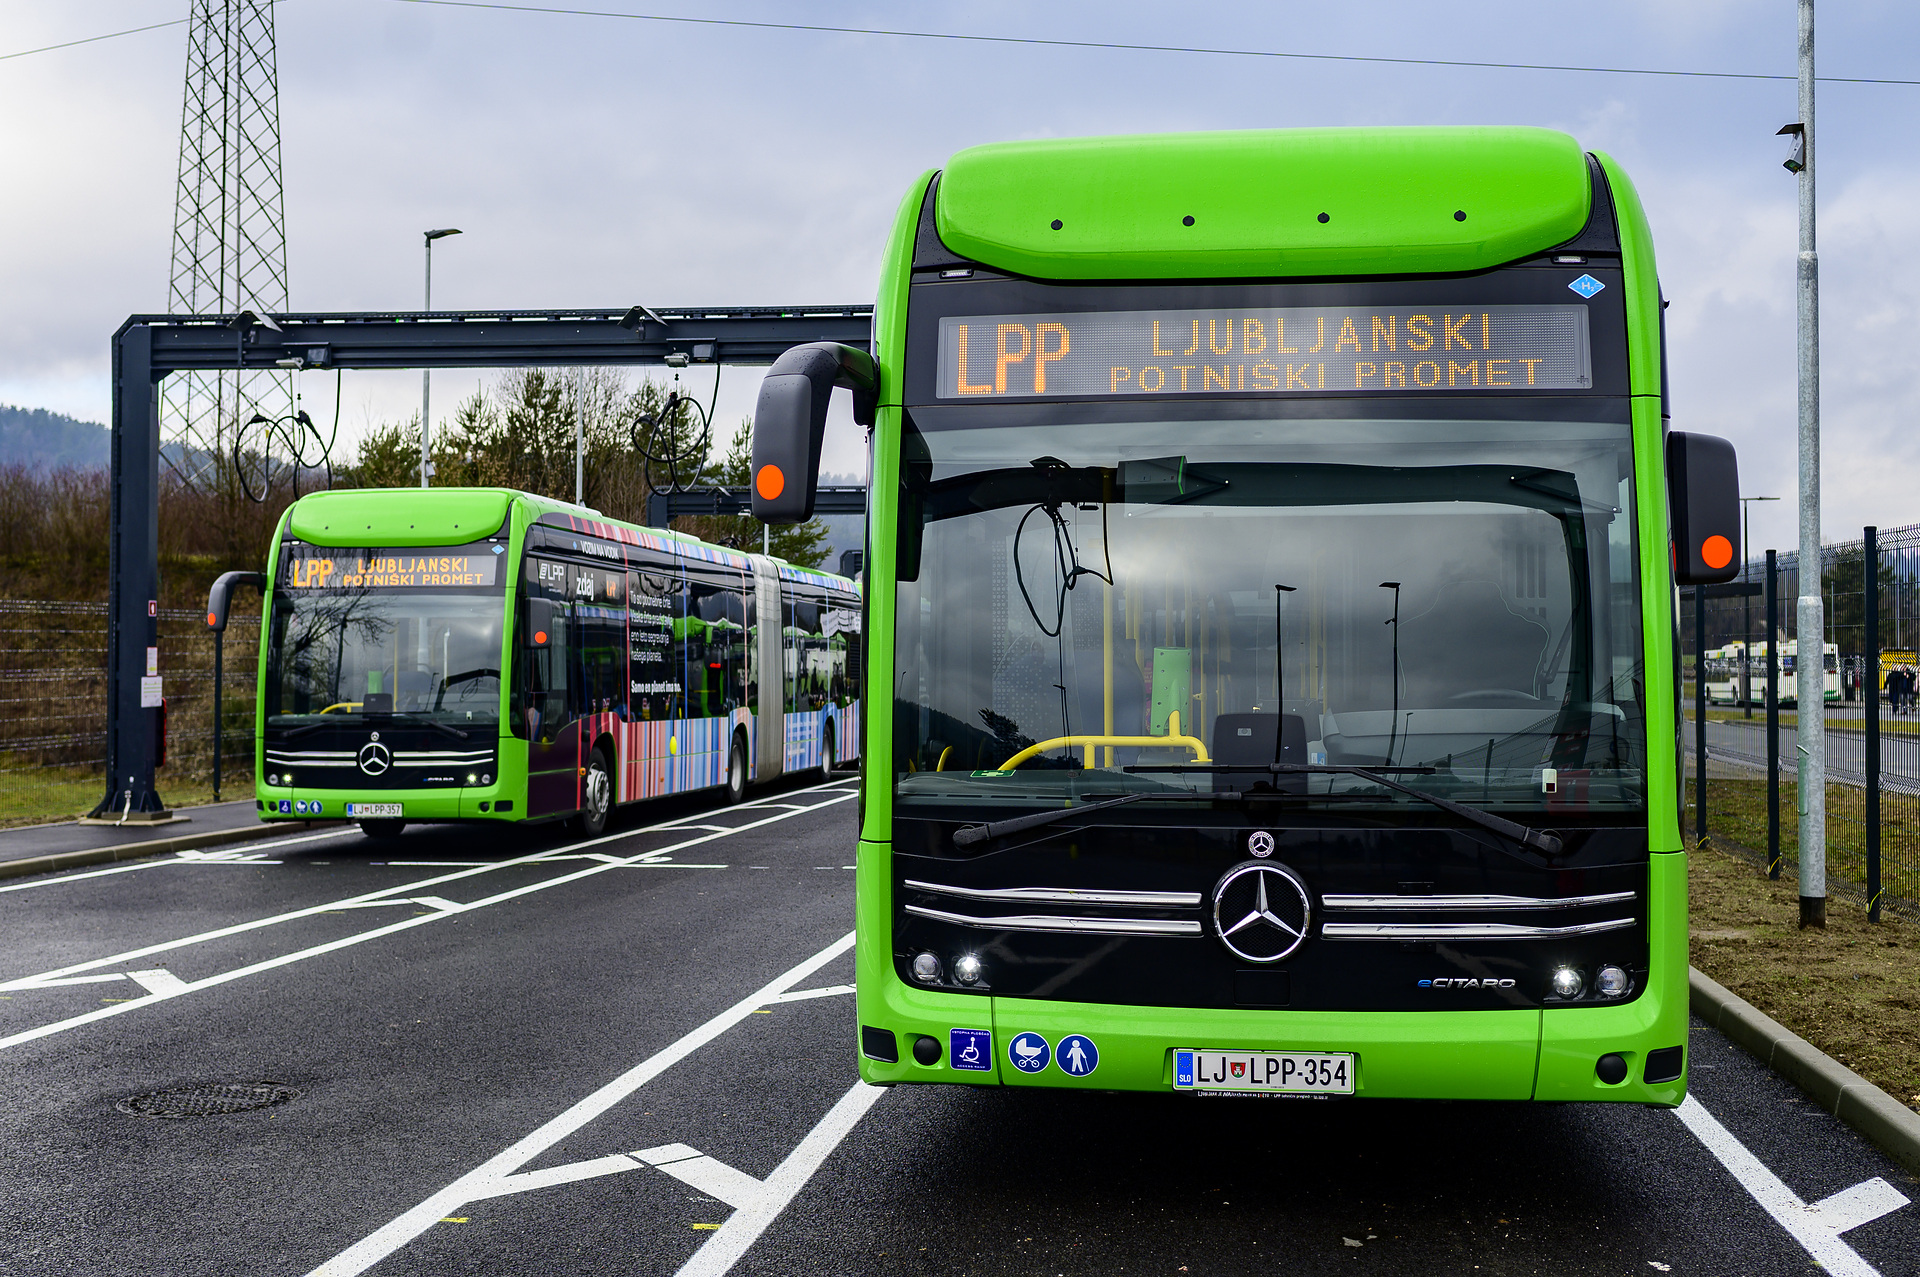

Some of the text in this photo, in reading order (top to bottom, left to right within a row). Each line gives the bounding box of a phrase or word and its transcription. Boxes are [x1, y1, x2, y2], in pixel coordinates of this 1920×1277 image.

[1153, 313, 1489, 356] LJUBLJANSKI
[958, 322, 1070, 395] LPP
[1111, 358, 1543, 392] POTNIŠKI PROMET
[293, 559, 333, 587] LPP
[357, 557, 468, 574] LJUBLJANSKI
[547, 563, 564, 581] LPP
[343, 573, 484, 586] POTNIŠKI PROMET
[576, 572, 594, 601] zdaj
[631, 679, 644, 693] Samo
[651, 680, 665, 696] planet
[353, 804, 400, 815] LJ LPP-357
[1417, 978, 1516, 989] eCITARO
[1179, 1074, 1192, 1083] SLO
[1197, 1056, 1347, 1087] LJ LPP-354
